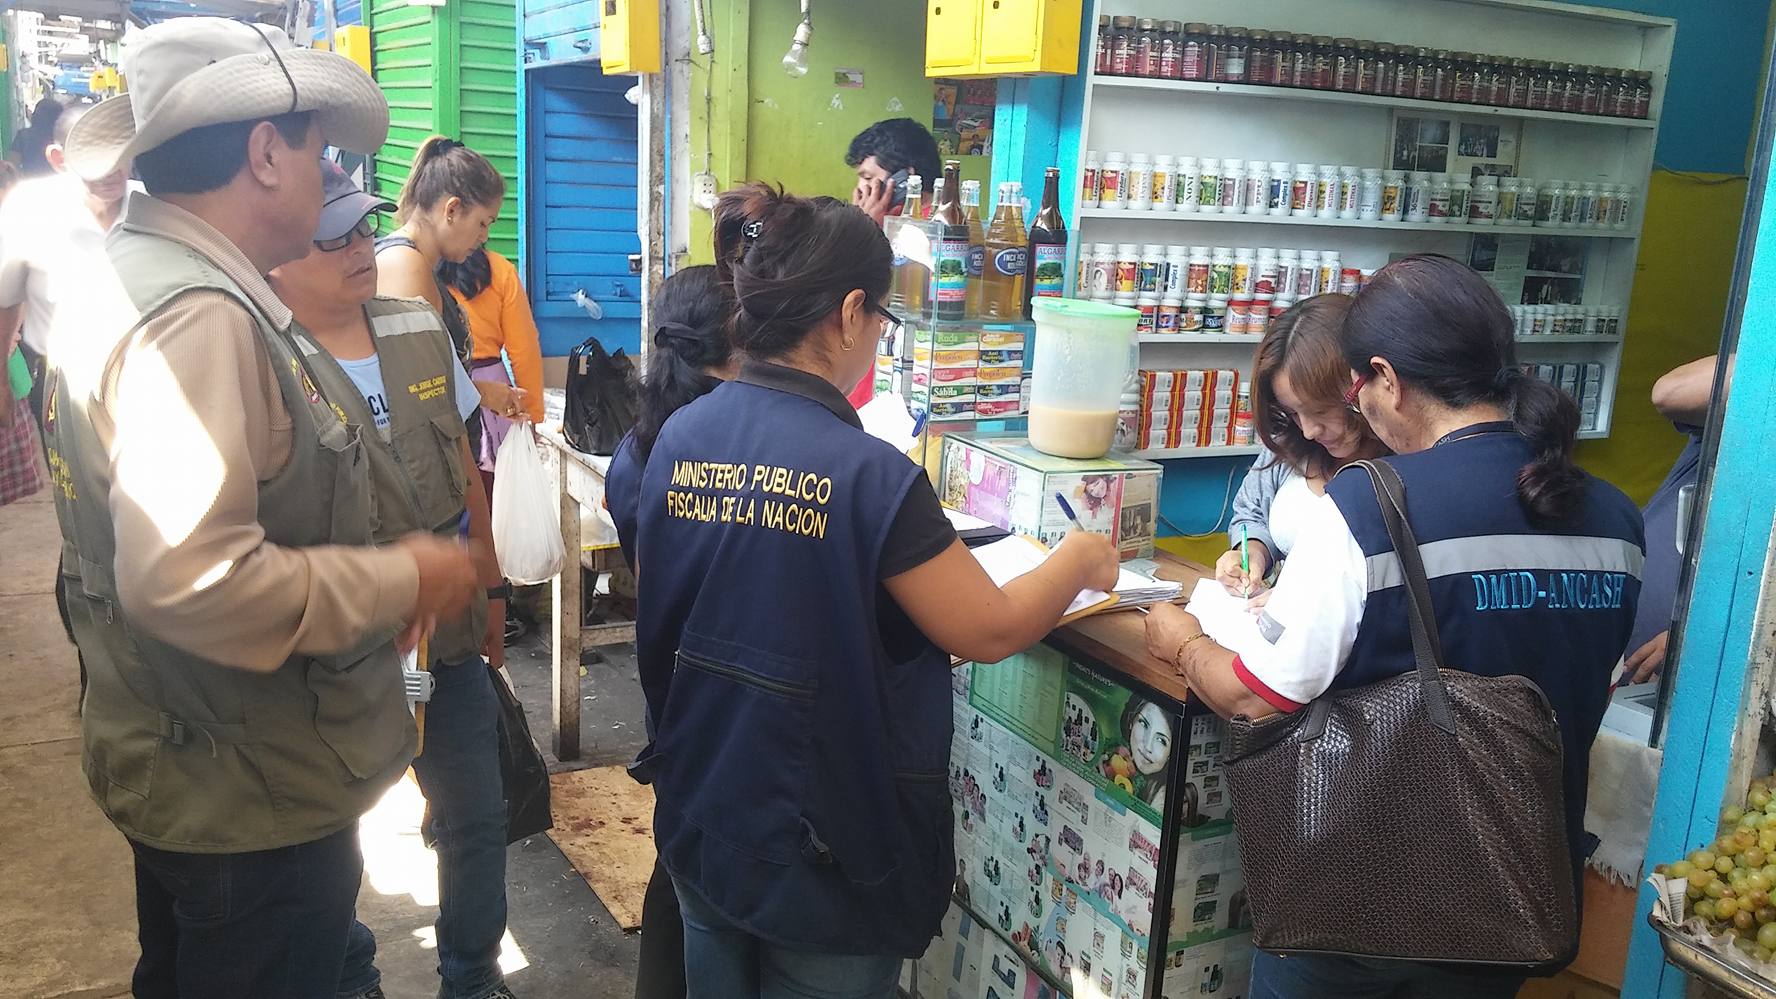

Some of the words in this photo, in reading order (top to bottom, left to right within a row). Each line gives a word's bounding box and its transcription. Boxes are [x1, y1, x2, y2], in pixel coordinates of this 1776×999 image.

[1186, 176, 1194, 201] NONI
[671, 460, 748, 491] MINISTERIO
[750, 464, 832, 506] PUBLICO
[667, 490, 717, 523] FISCALIA
[720, 496, 736, 523] DE
[736, 497, 755, 526] LA
[761, 499, 828, 540] NACION
[1471, 571, 1627, 611] DMID-ANCASH
